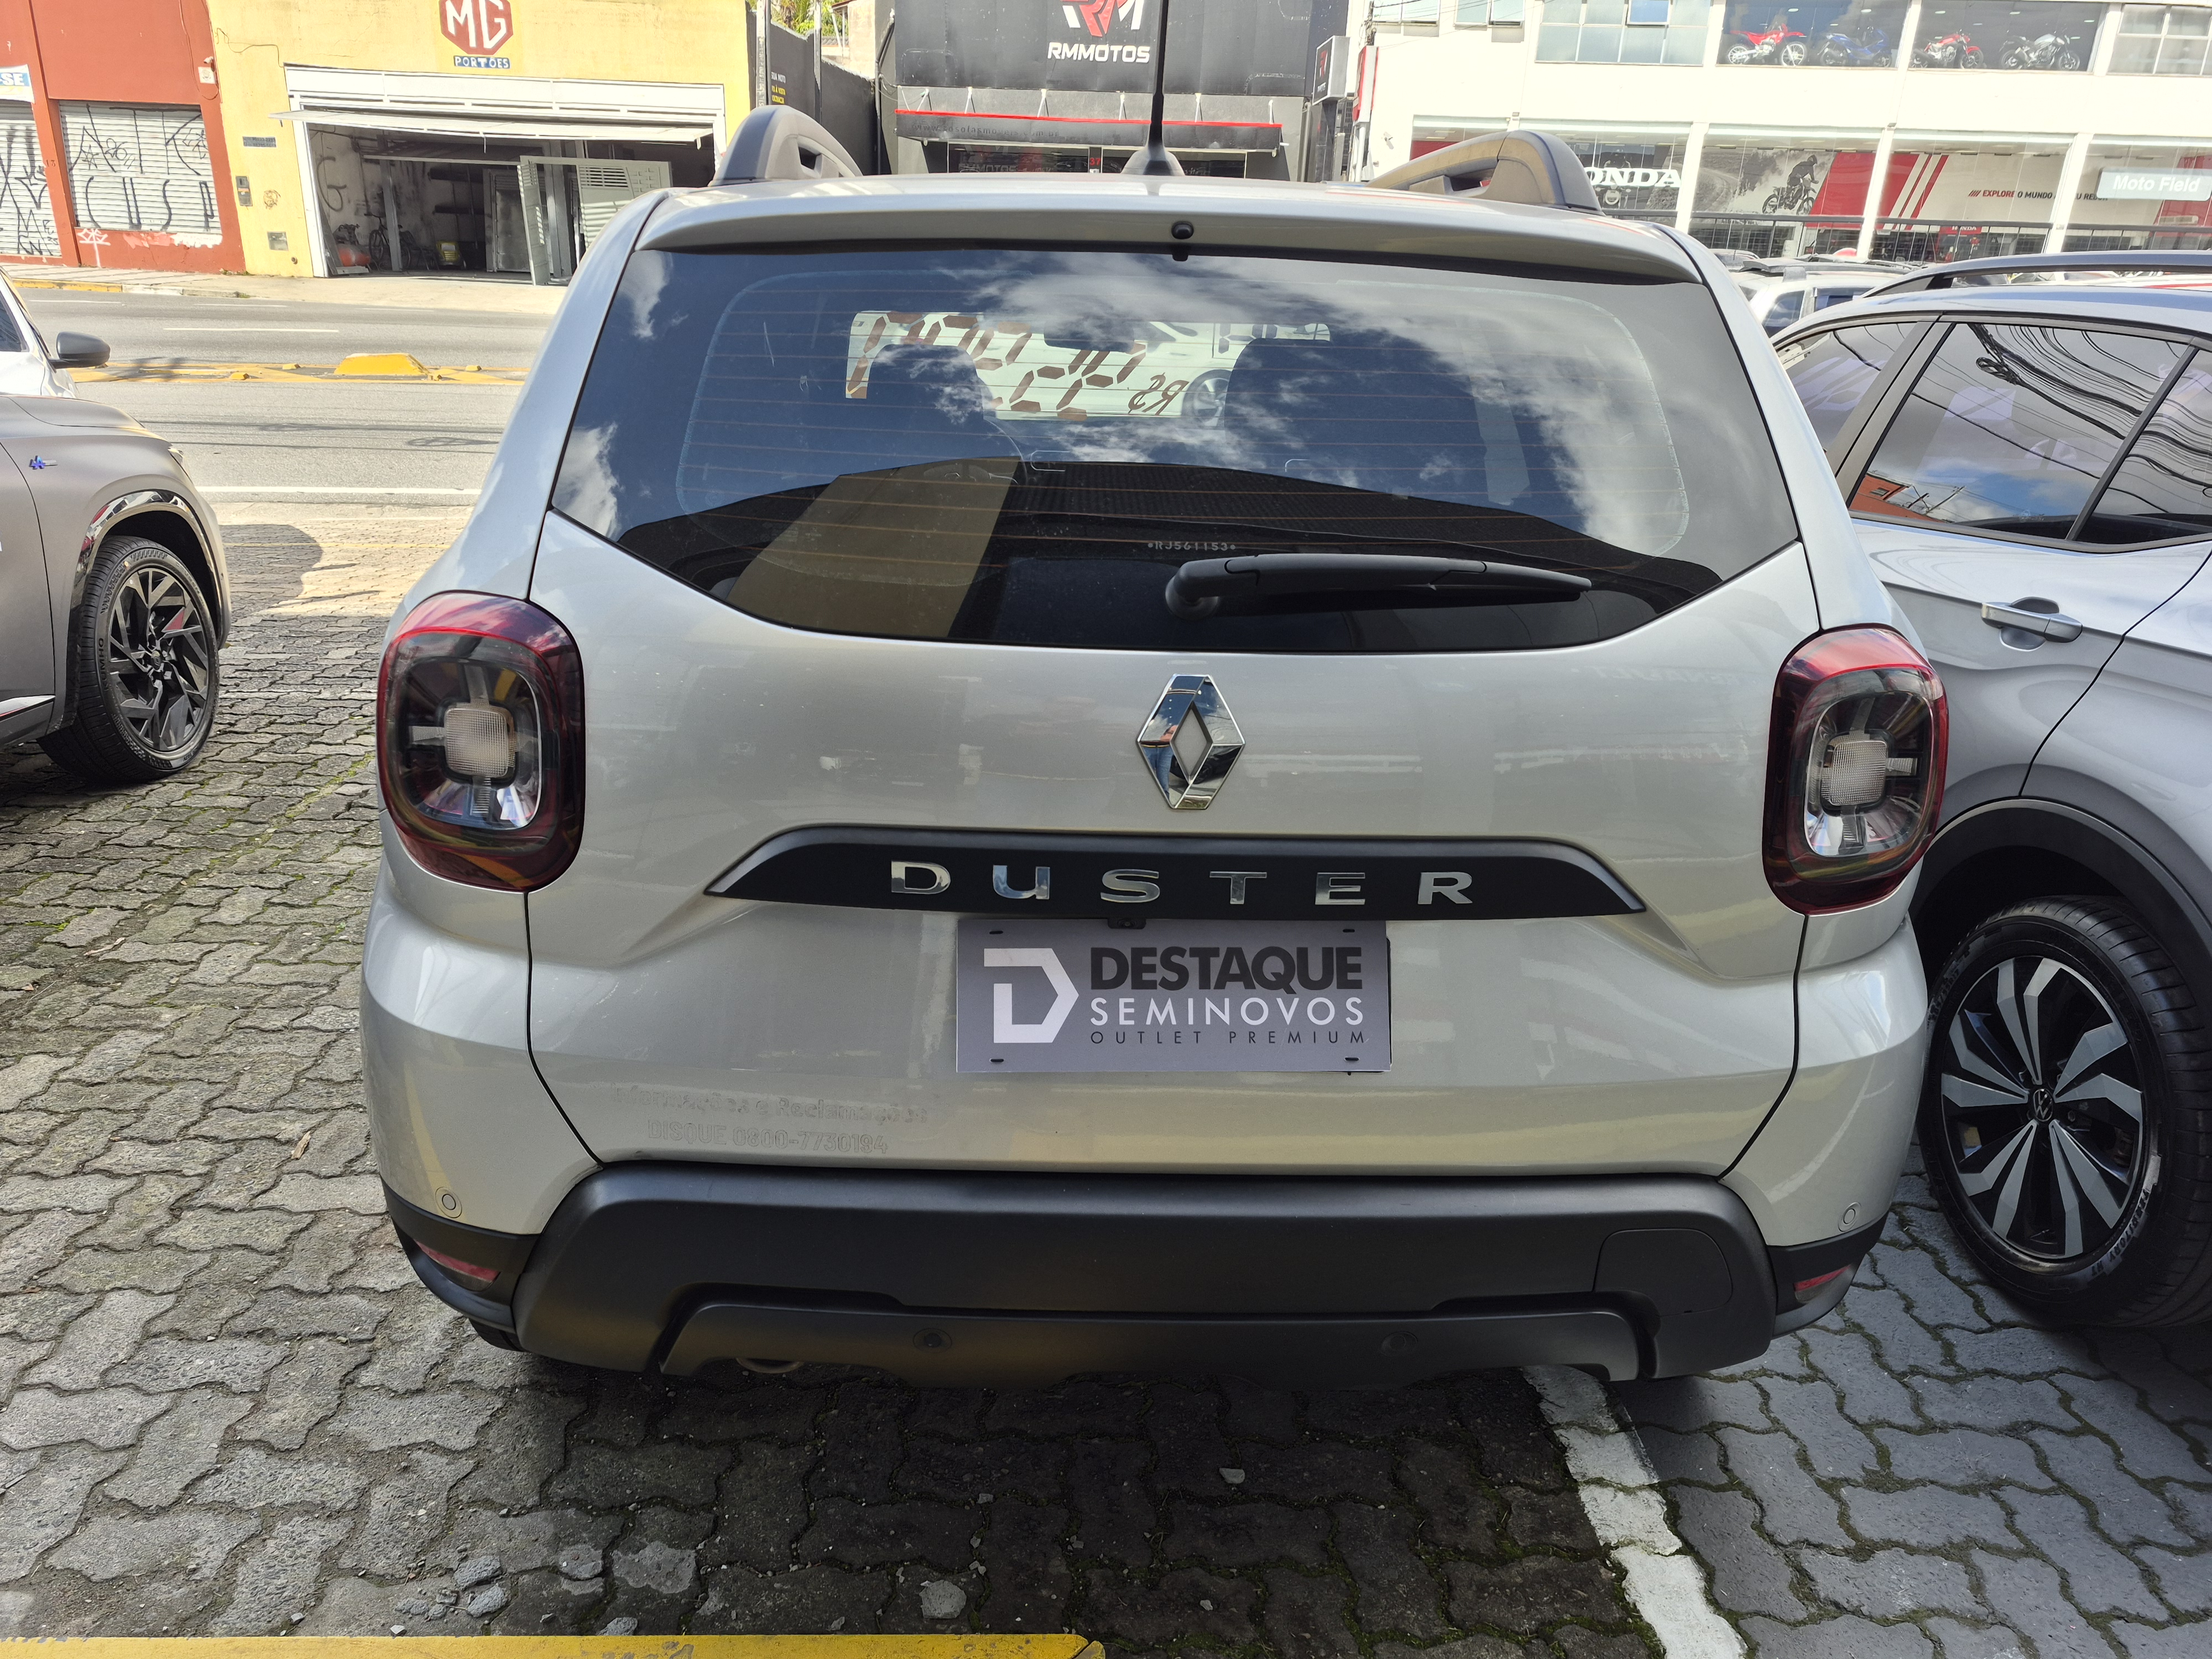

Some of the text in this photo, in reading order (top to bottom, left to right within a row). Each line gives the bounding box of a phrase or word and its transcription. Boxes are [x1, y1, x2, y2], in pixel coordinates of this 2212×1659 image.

[445, 0, 507, 49] MG
[455, 56, 509, 68] PORTÕES
[1047, 41, 1150, 64] RMMOTOS
[1090, 158, 1101, 166] 37
[1584, 166, 1682, 187] ONDA
[2113, 175, 2200, 192] Moto Field
[891, 860, 1473, 905] DUSTER
[1091, 946, 1363, 994] DESTAQUE
[1091, 997, 1364, 1026] SEMINOVOS
[1091, 1031, 1364, 1044] OUTLET PREMIUM
[648, 1119, 888, 1154] DISQUE 0800-7730194
